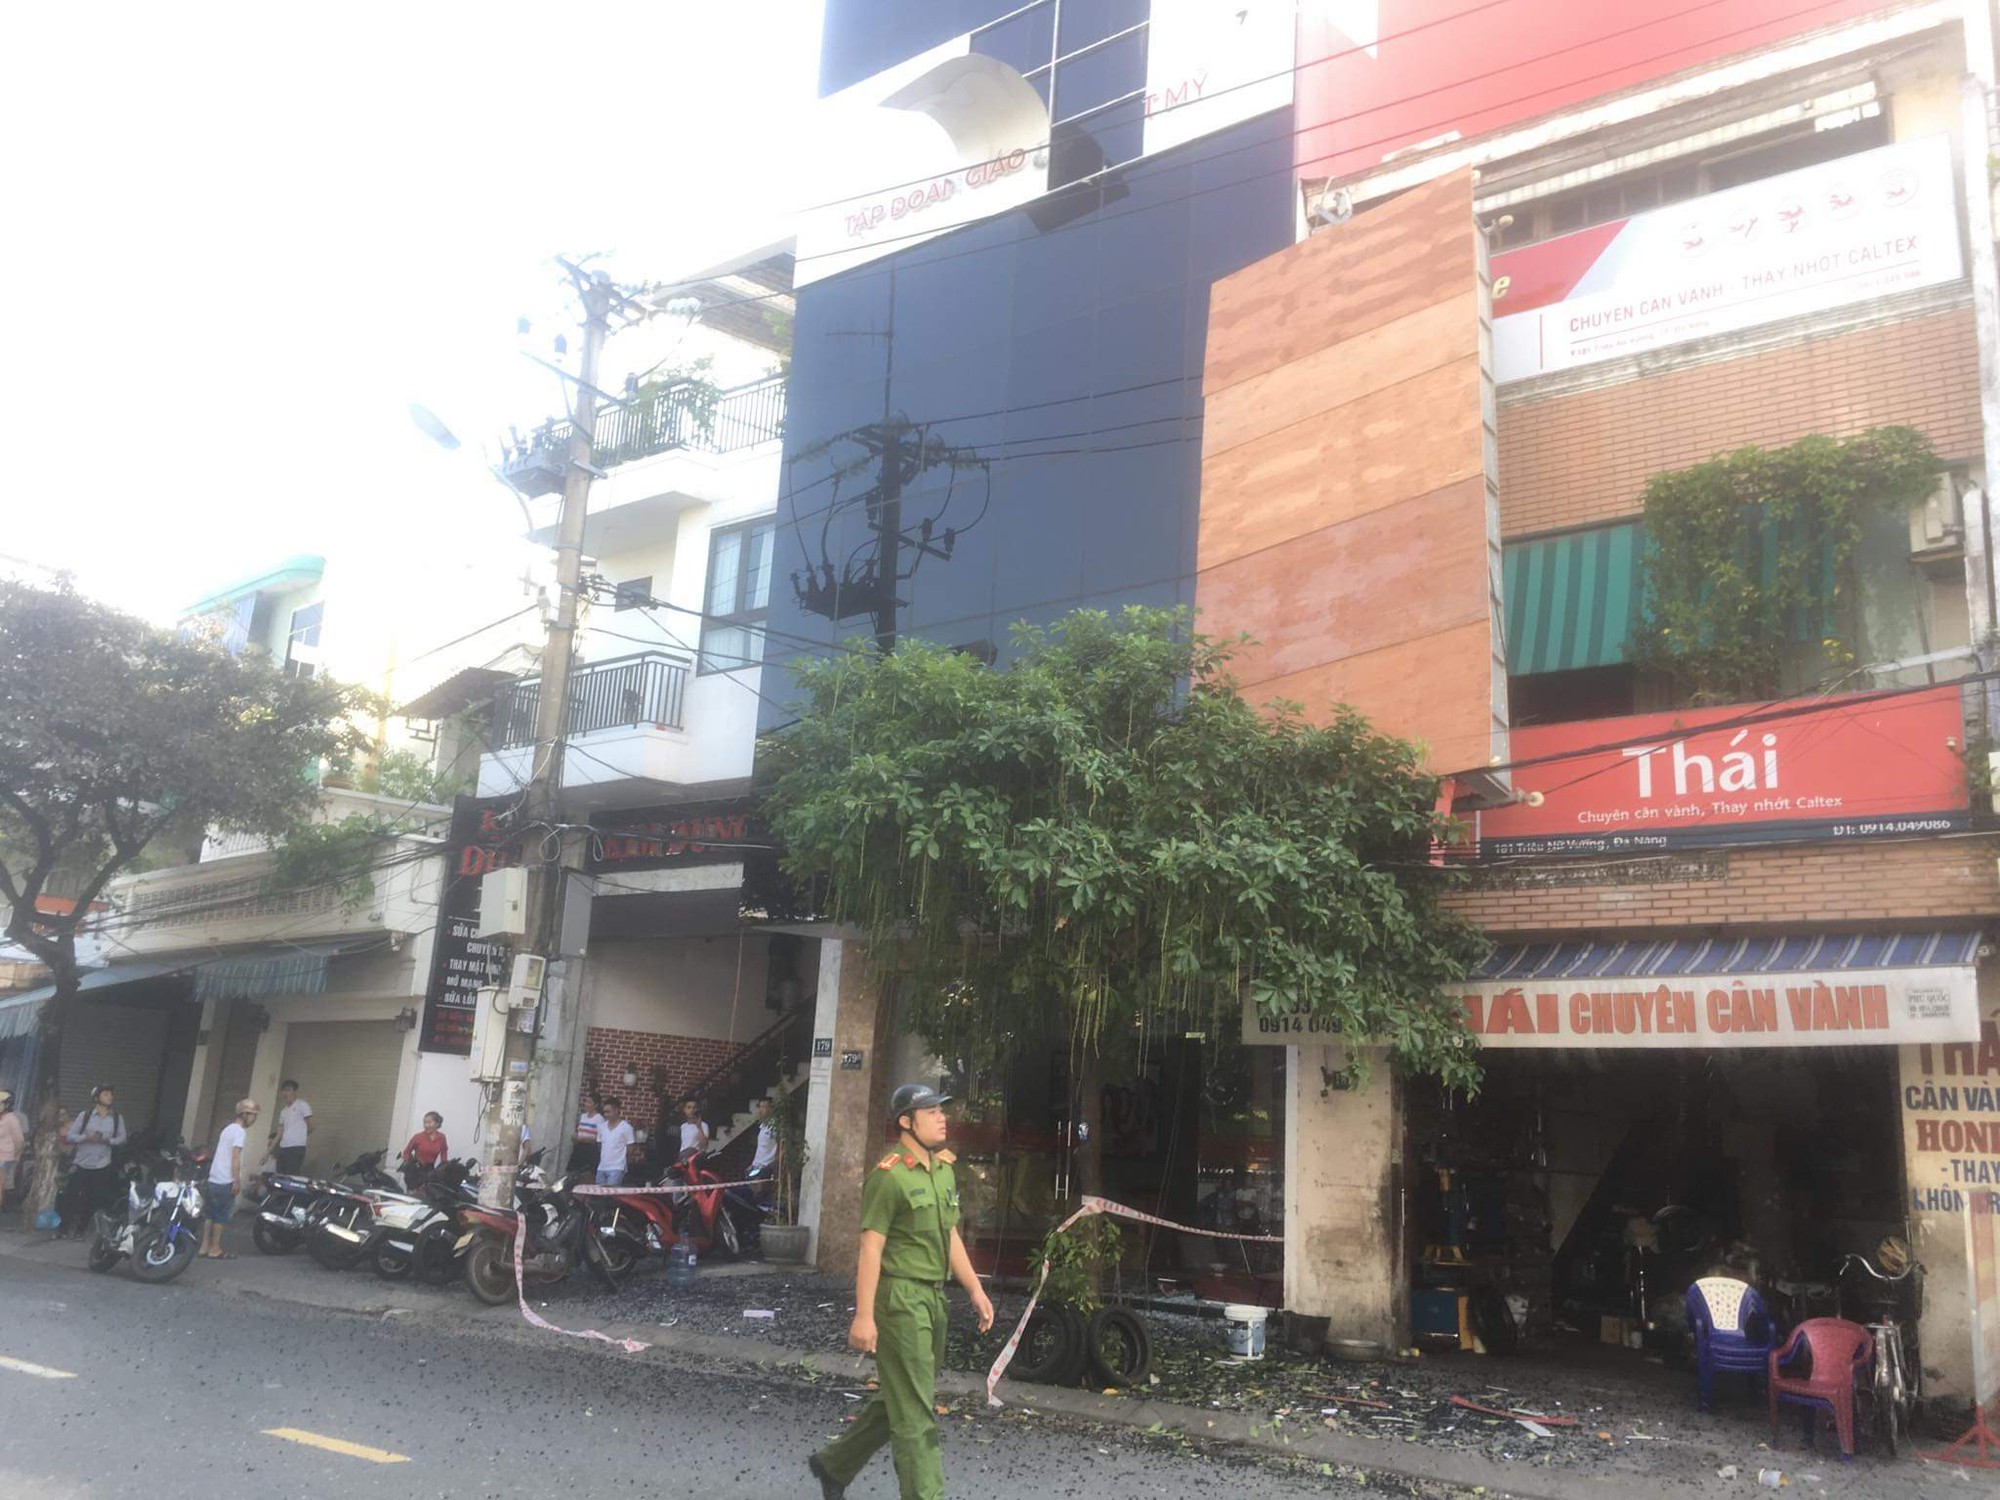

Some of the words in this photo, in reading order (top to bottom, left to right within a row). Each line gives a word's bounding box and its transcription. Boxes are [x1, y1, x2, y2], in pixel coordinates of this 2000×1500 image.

[1848, 235, 1917, 265] CALTEX
[1622, 729, 1778, 798] Thái
[1577, 808, 1630, 824] Chuyên
[1634, 808, 1659, 821] cân
[1711, 801, 1748, 817] Thay
[1753, 797, 1790, 812] nhớt
[1796, 796, 1843, 810] Caltex
[1569, 983, 1698, 1035] CHUYÊN
[1706, 979, 1779, 1034] CÂN
[1786, 979, 1890, 1032] VÀNH
[1259, 1016, 1302, 1034] 0914
[816, 1041, 830, 1051] 179
[1905, 1080, 1959, 1112] CÂN
